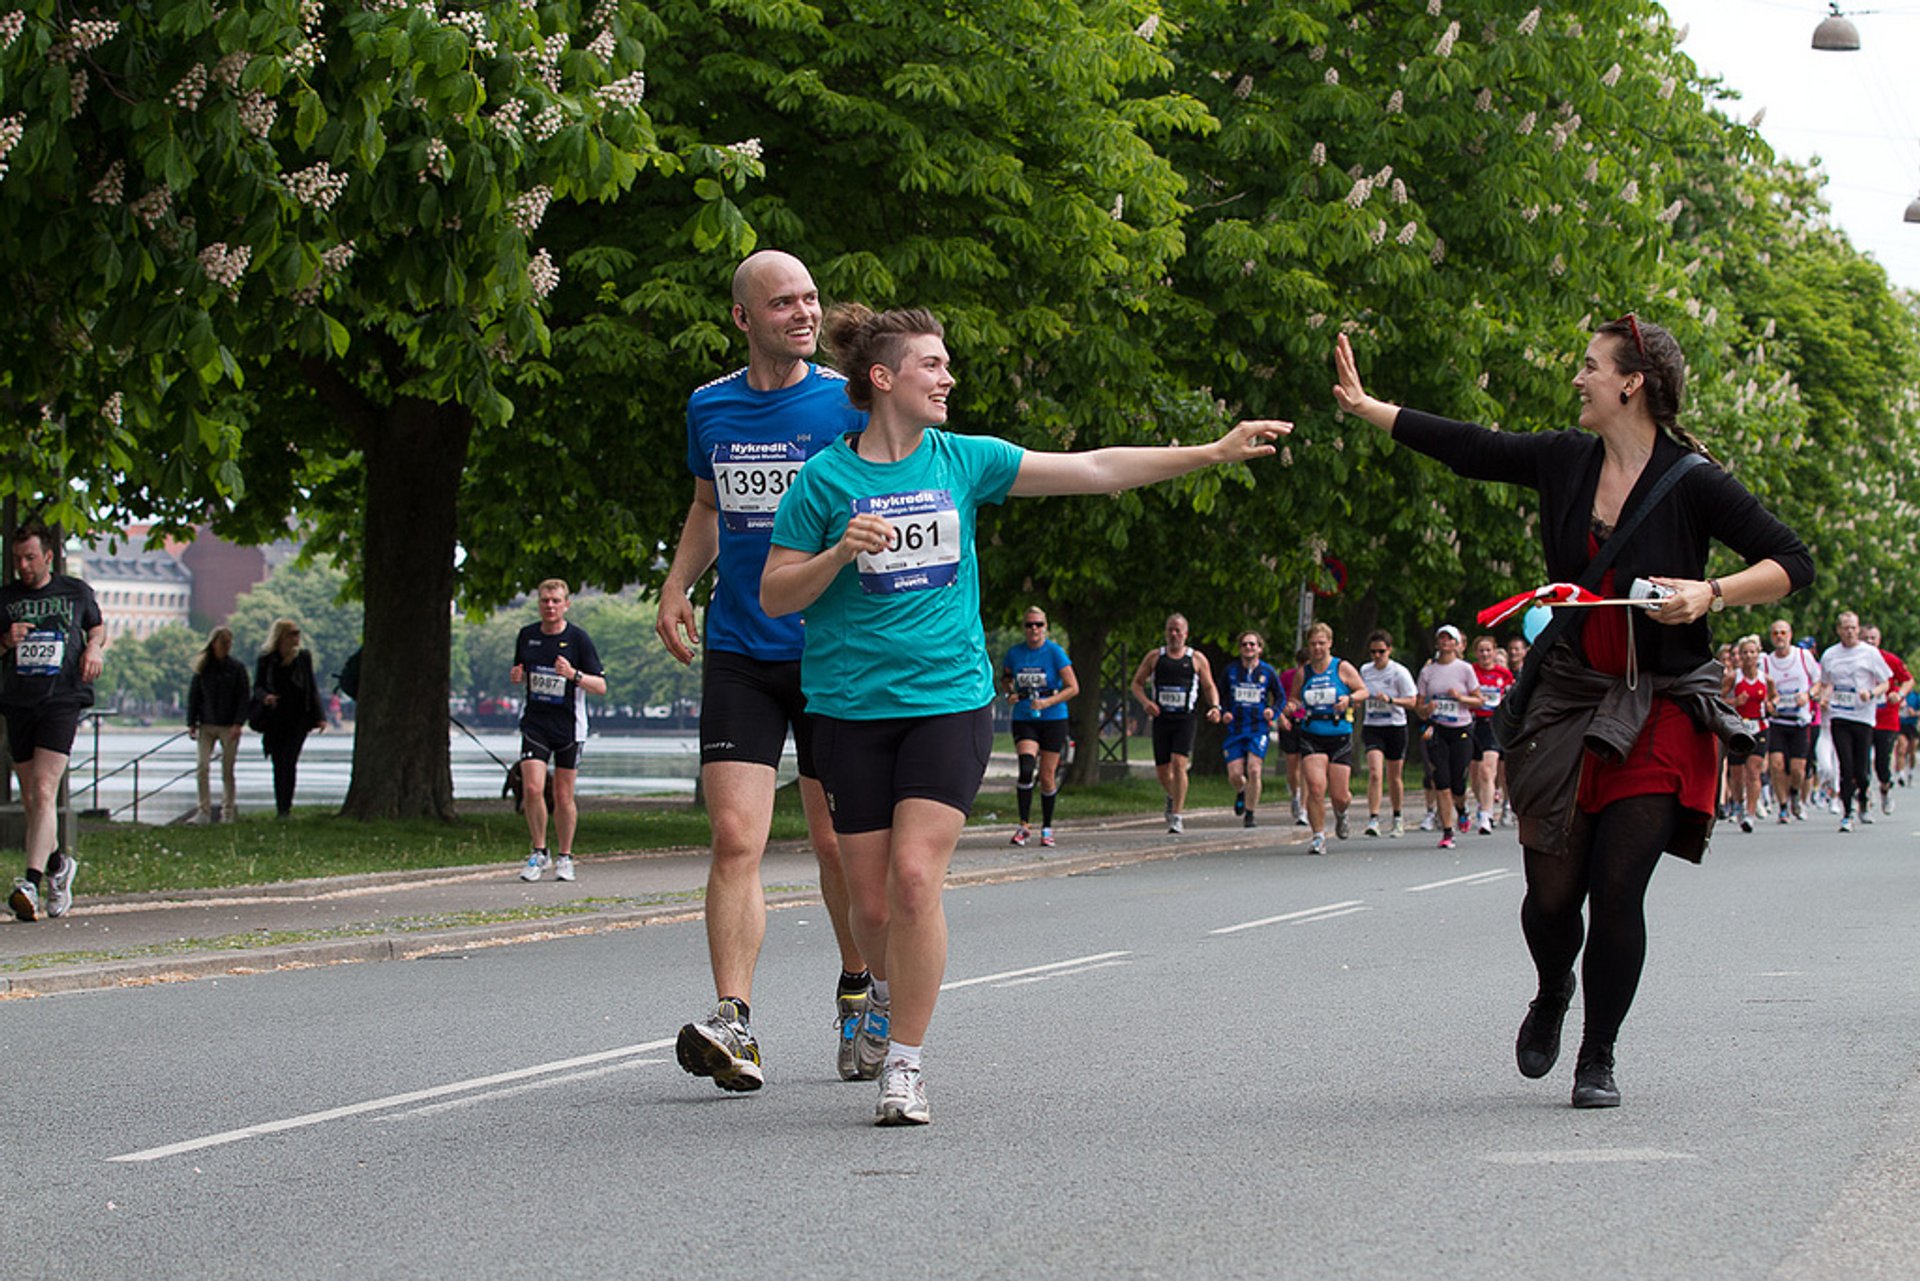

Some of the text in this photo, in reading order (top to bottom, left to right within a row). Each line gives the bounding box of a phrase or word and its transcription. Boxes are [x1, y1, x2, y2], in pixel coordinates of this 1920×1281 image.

[731, 443, 787, 454] Nykredit
[870, 493, 934, 509] Nykredit
[868, 520, 939, 556] 061
[21, 645, 56, 658] 2029
